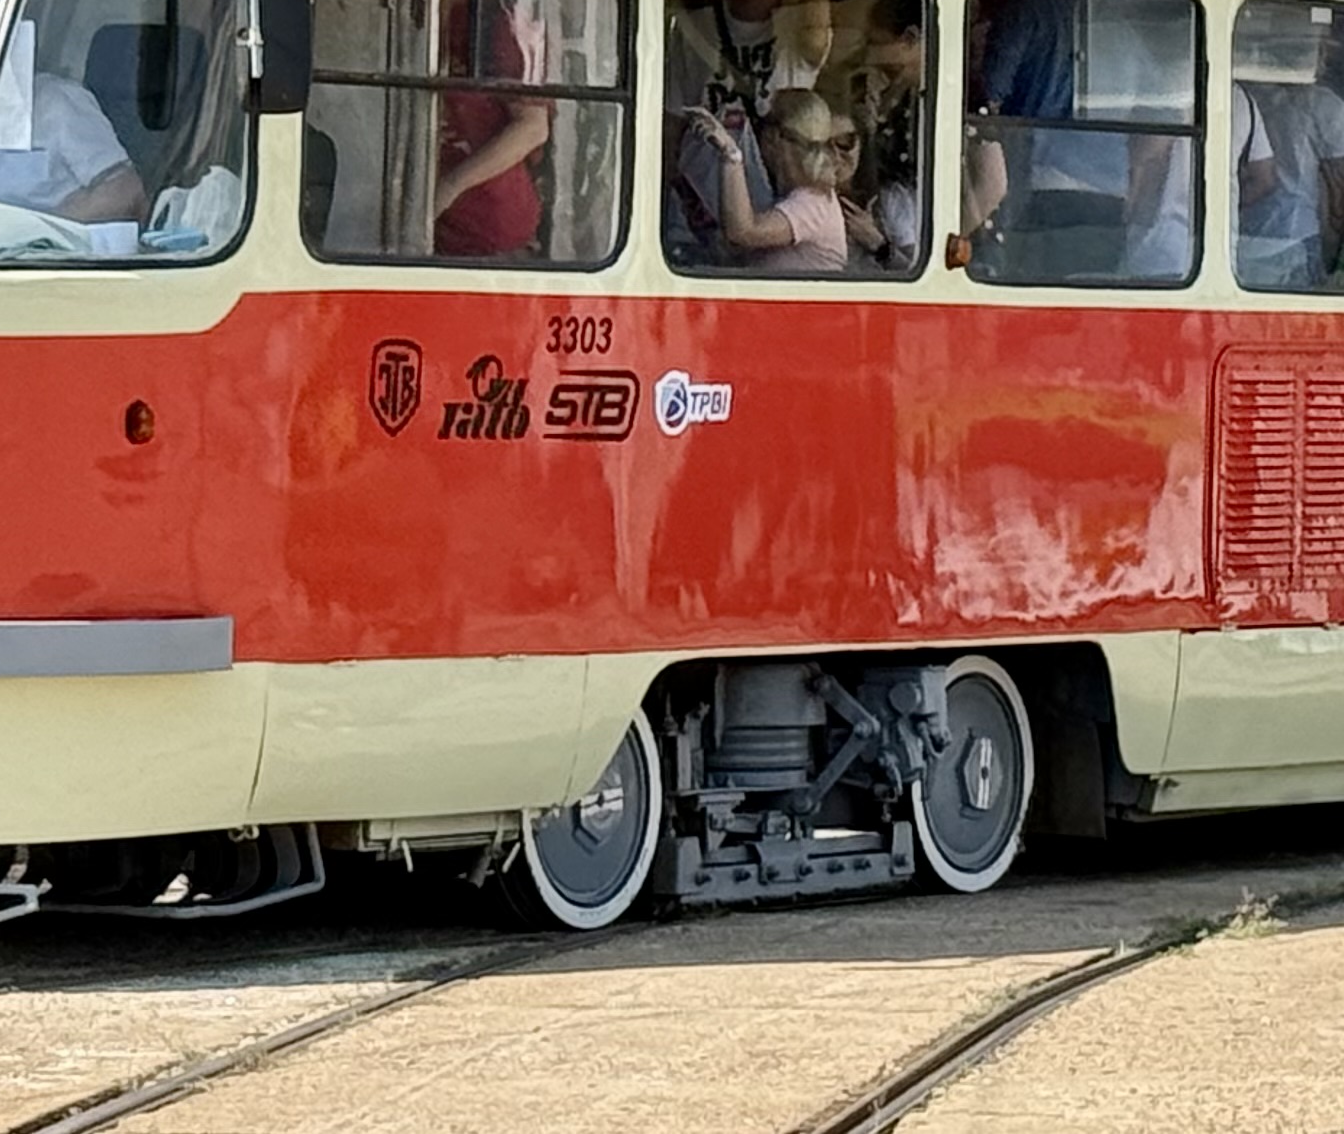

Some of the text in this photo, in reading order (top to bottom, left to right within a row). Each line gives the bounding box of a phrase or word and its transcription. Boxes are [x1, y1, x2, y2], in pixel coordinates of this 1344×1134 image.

[546, 317, 612, 353] 3303
[545, 385, 630, 426] STB
[690, 387, 729, 415] TPBI
